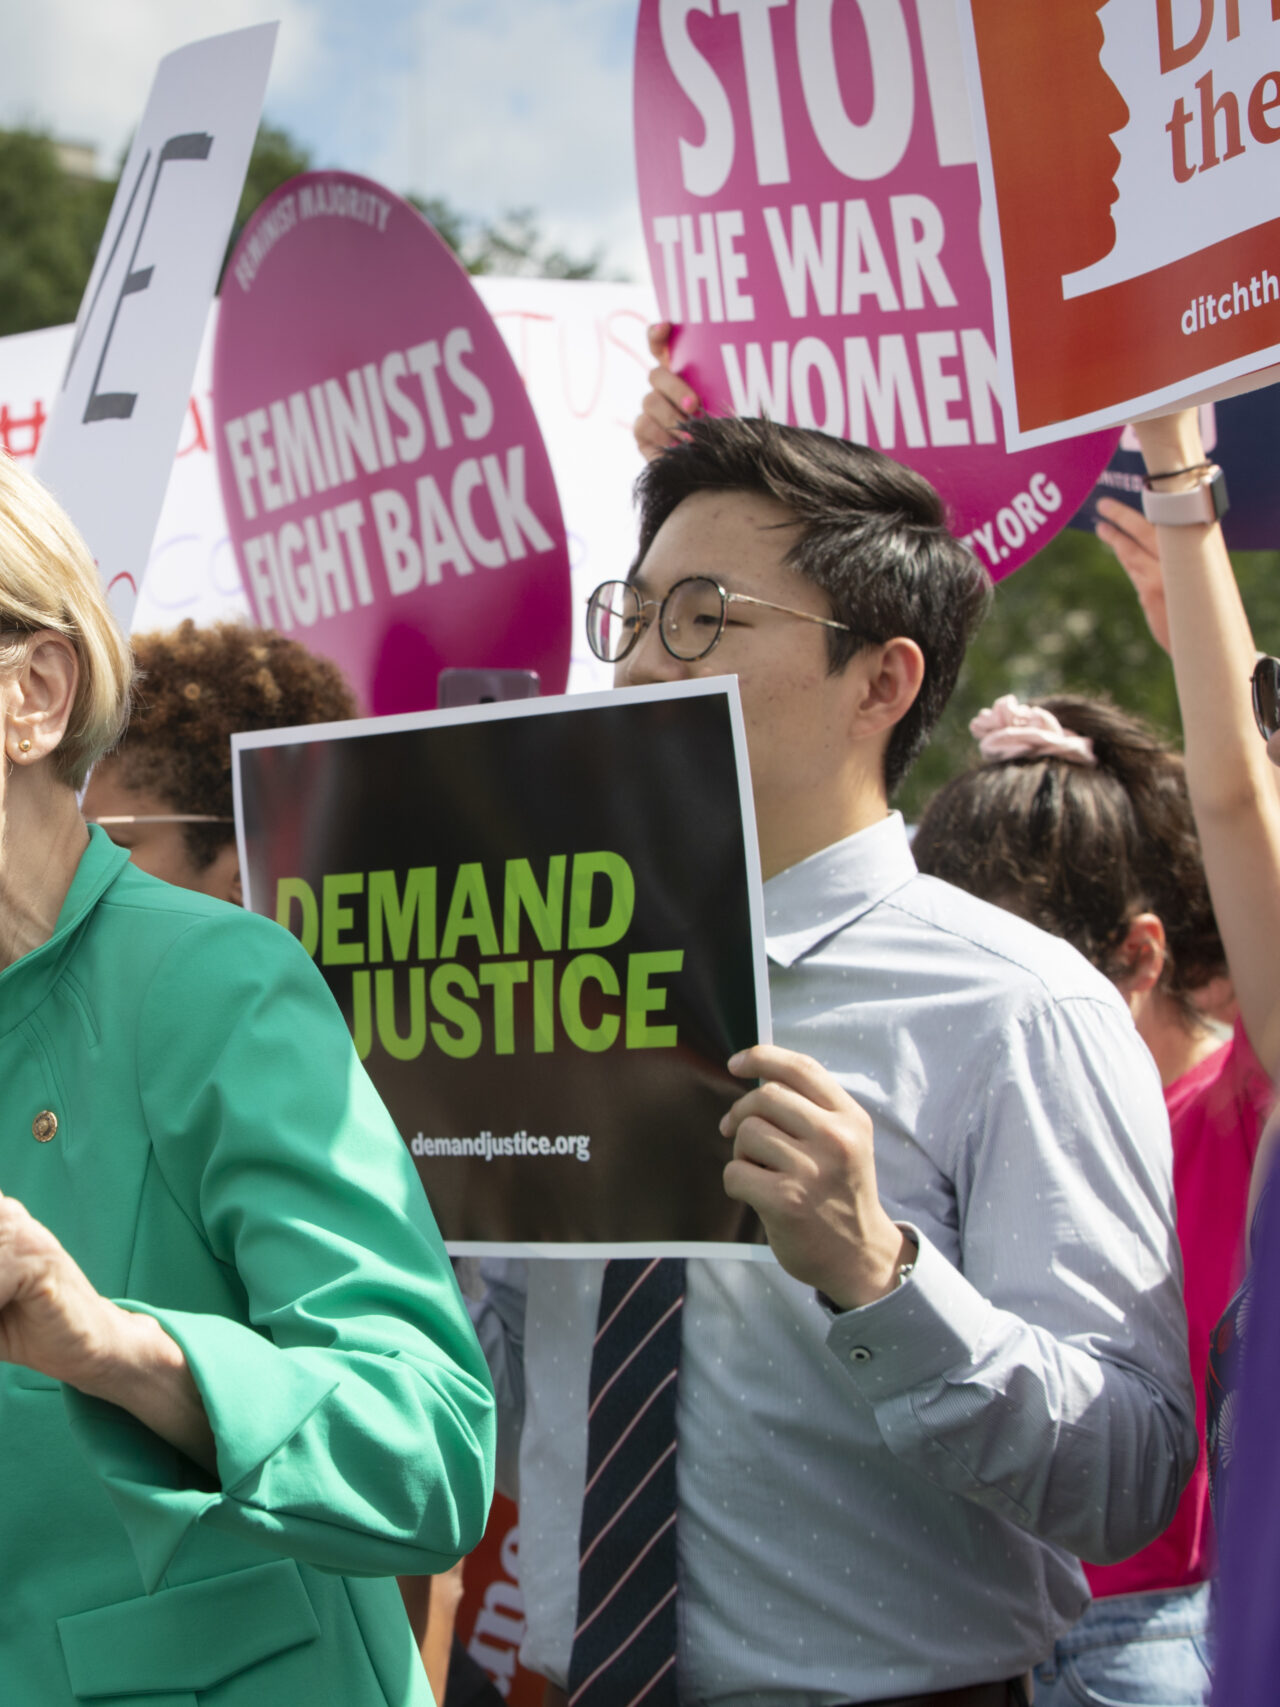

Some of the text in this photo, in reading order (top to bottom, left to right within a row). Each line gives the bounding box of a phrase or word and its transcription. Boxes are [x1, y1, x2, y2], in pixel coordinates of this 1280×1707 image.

[658, 0, 978, 198] STO
[653, 210, 755, 324] THE
[763, 194, 959, 319] WAR
[224, 327, 494, 519] FEMINISTS
[243, 499, 376, 632] FIGHT
[370, 446, 555, 596] BACK
[276, 850, 636, 966] DEMAND
[352, 949, 685, 1062] JUSTICE
[411, 1131, 591, 1162] demandjustice.org
